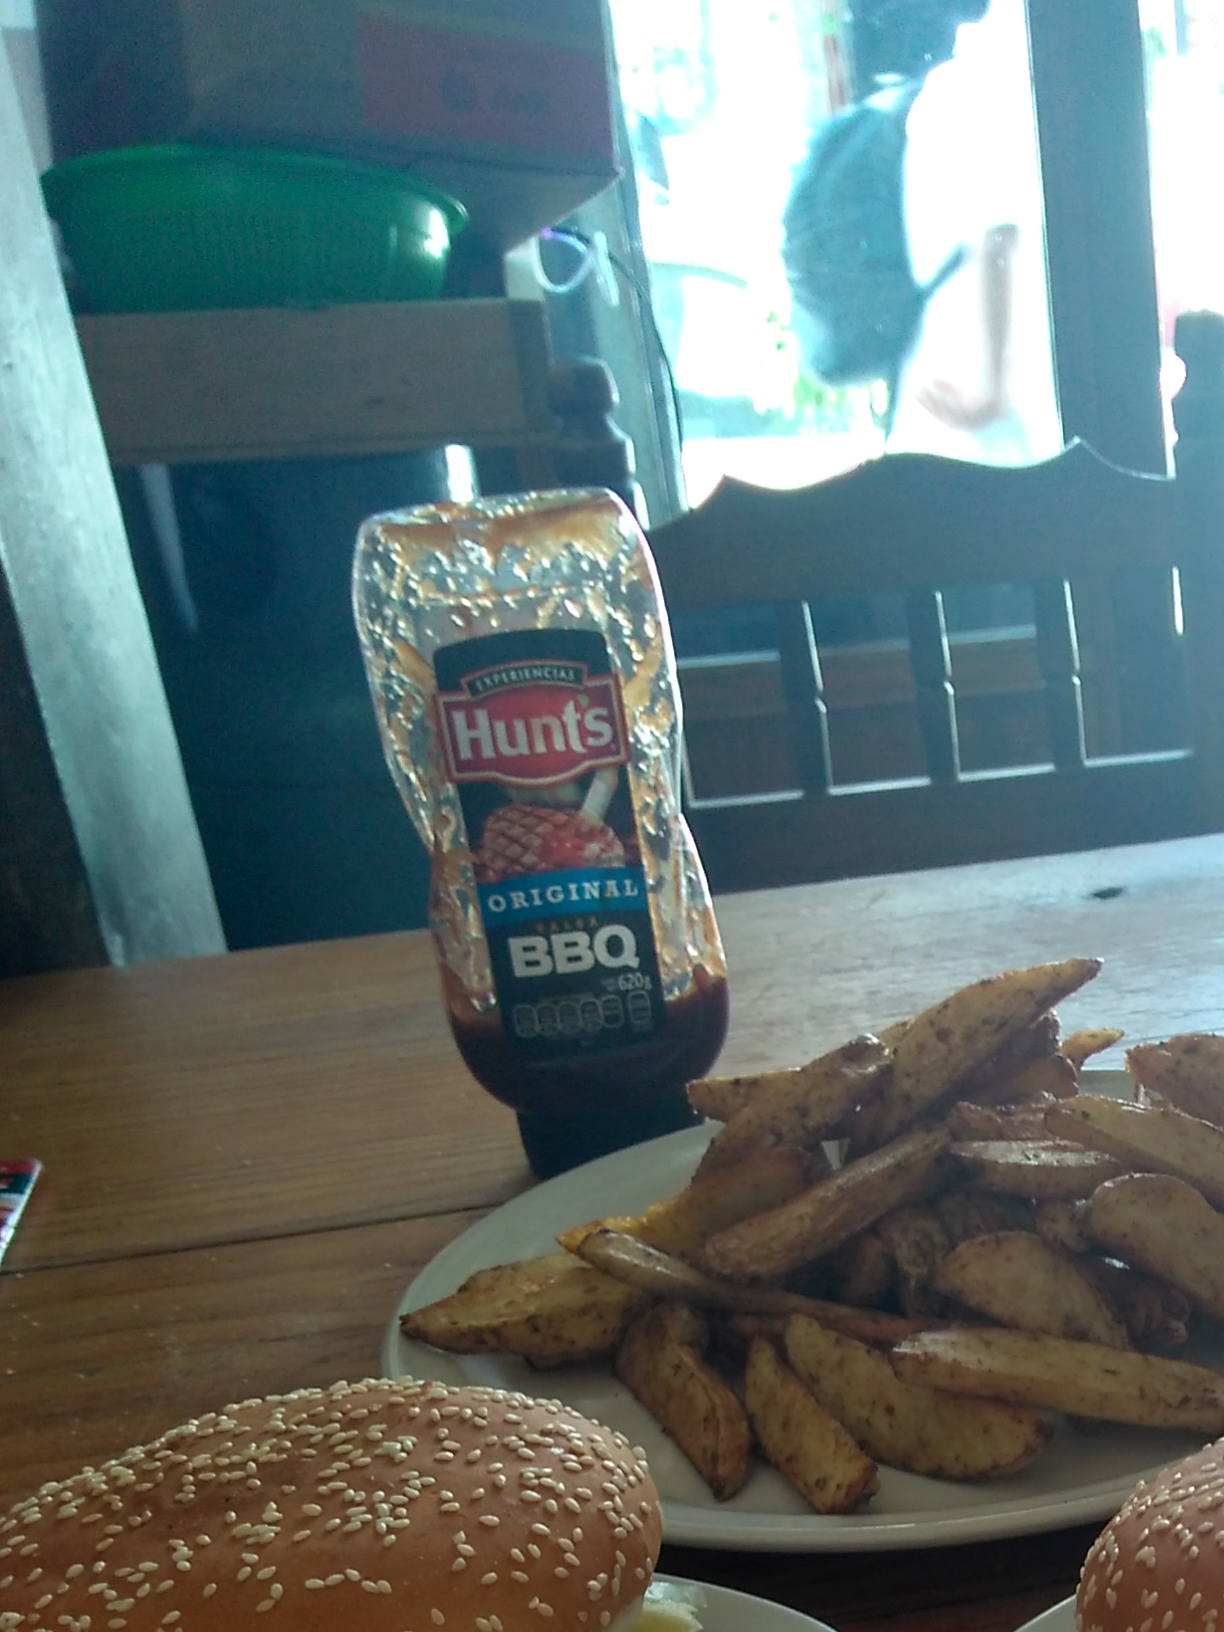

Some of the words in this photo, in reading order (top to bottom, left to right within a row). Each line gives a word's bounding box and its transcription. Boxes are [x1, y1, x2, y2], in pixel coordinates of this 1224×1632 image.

[475, 666, 576, 692] EXPERIENCIAS
[451, 694, 613, 761] Hunt's
[488, 876, 639, 913] ORIGINAL
[508, 923, 640, 979] BBQ
